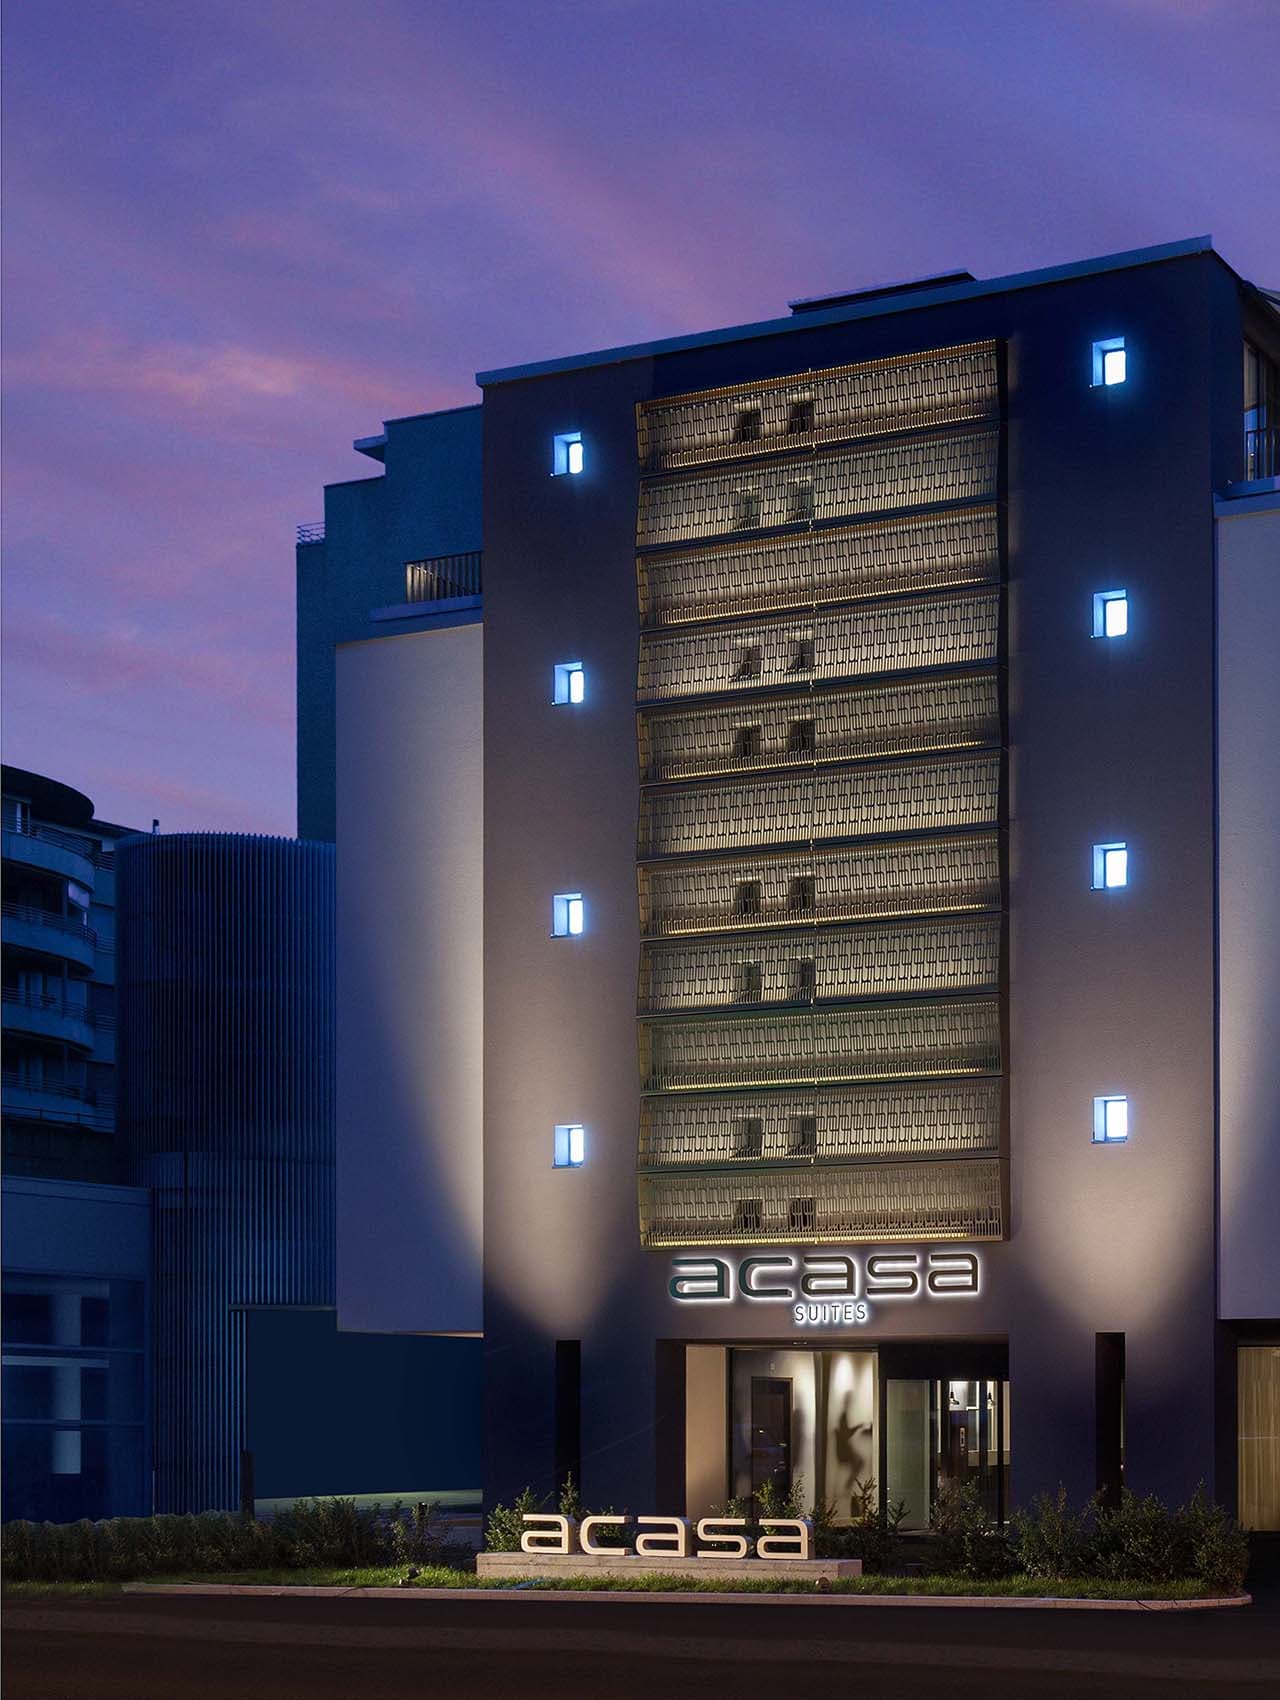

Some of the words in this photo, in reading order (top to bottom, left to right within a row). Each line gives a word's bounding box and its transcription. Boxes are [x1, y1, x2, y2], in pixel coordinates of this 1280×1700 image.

[668, 1252, 981, 1300] acasa
[794, 1302, 868, 1324] SUITES
[520, 1512, 815, 1560] acasa
